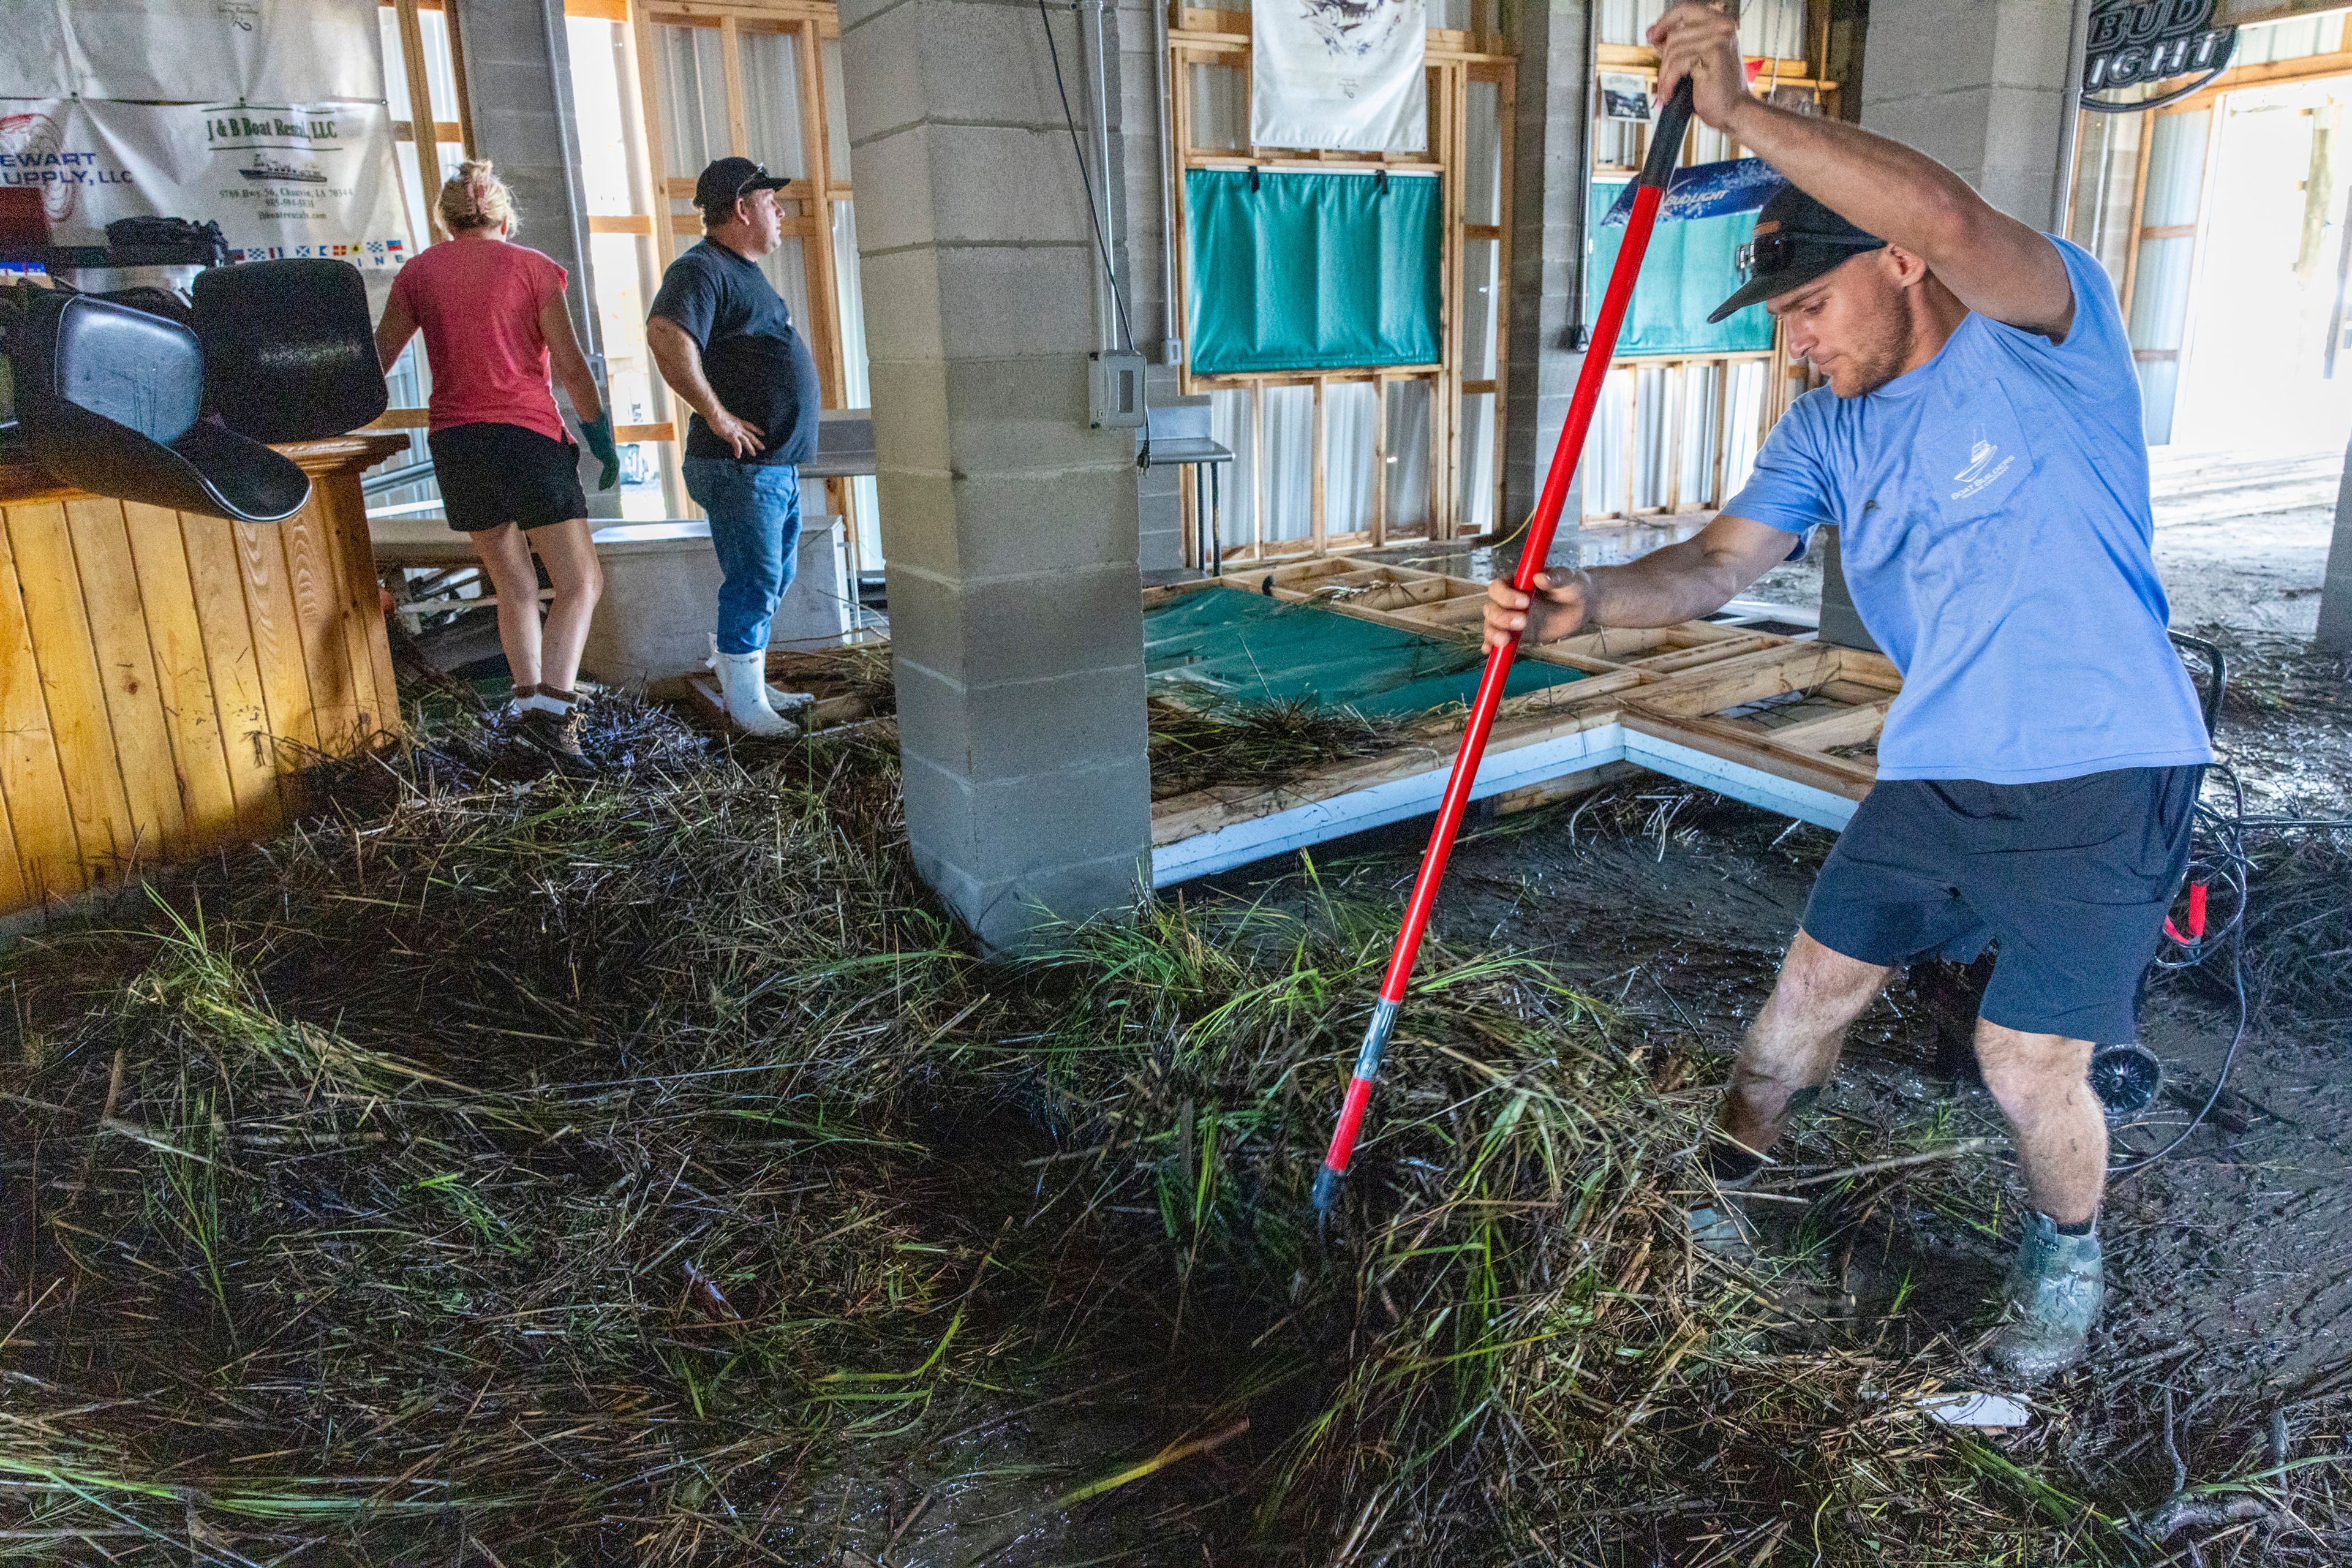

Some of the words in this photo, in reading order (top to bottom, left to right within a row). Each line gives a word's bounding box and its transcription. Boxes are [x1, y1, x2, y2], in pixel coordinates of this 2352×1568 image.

[2084, 0, 2216, 53] BUD
[207, 119, 213, 141] J
[217, 119, 227, 137] &
[228, 118, 241, 137] B
[241, 117, 273, 137] Boat
[310, 121, 337, 138] LLC
[98, 170, 135, 184] LLC
[315, 188, 326, 198] LA
[1950, 484, 1974, 500] BOAT
[1973, 454, 2015, 487] BUILDERS
